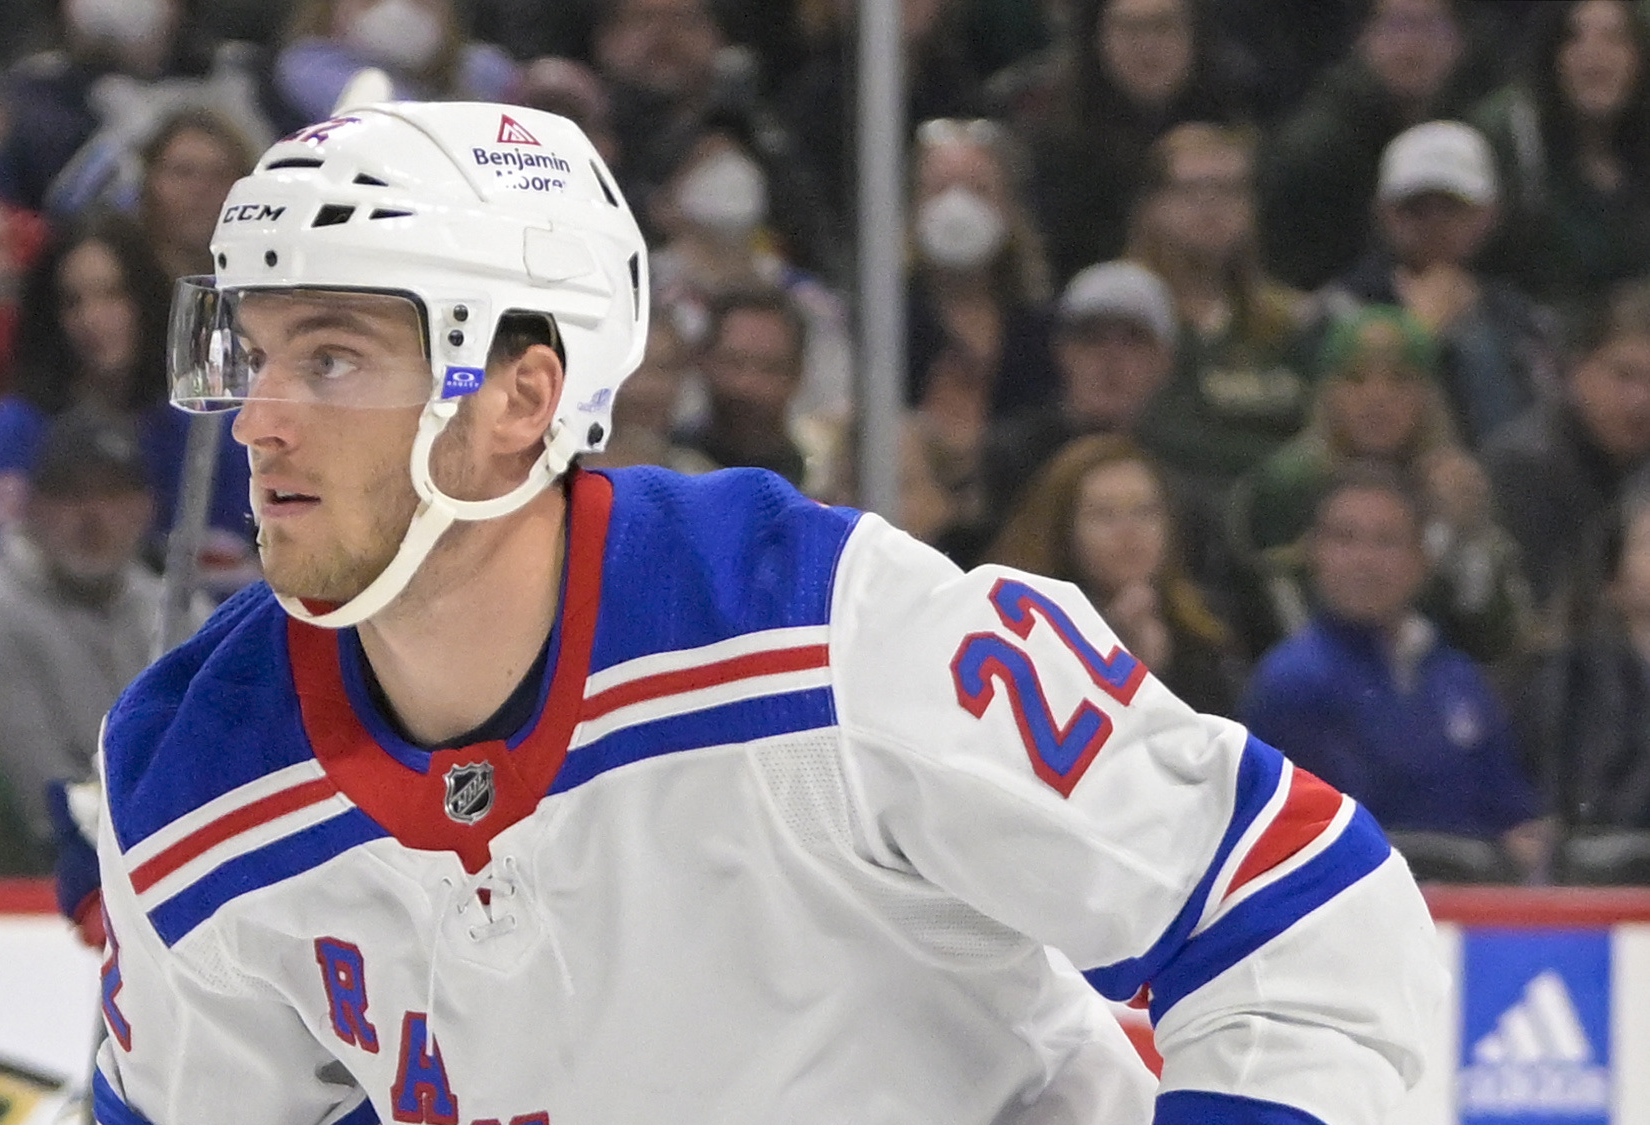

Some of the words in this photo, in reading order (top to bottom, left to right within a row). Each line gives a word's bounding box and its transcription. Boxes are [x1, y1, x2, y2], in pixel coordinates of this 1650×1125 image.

[472, 147, 572, 173] Benjamin
[223, 204, 286, 224] CCM
[950, 577, 1149, 800] 22
